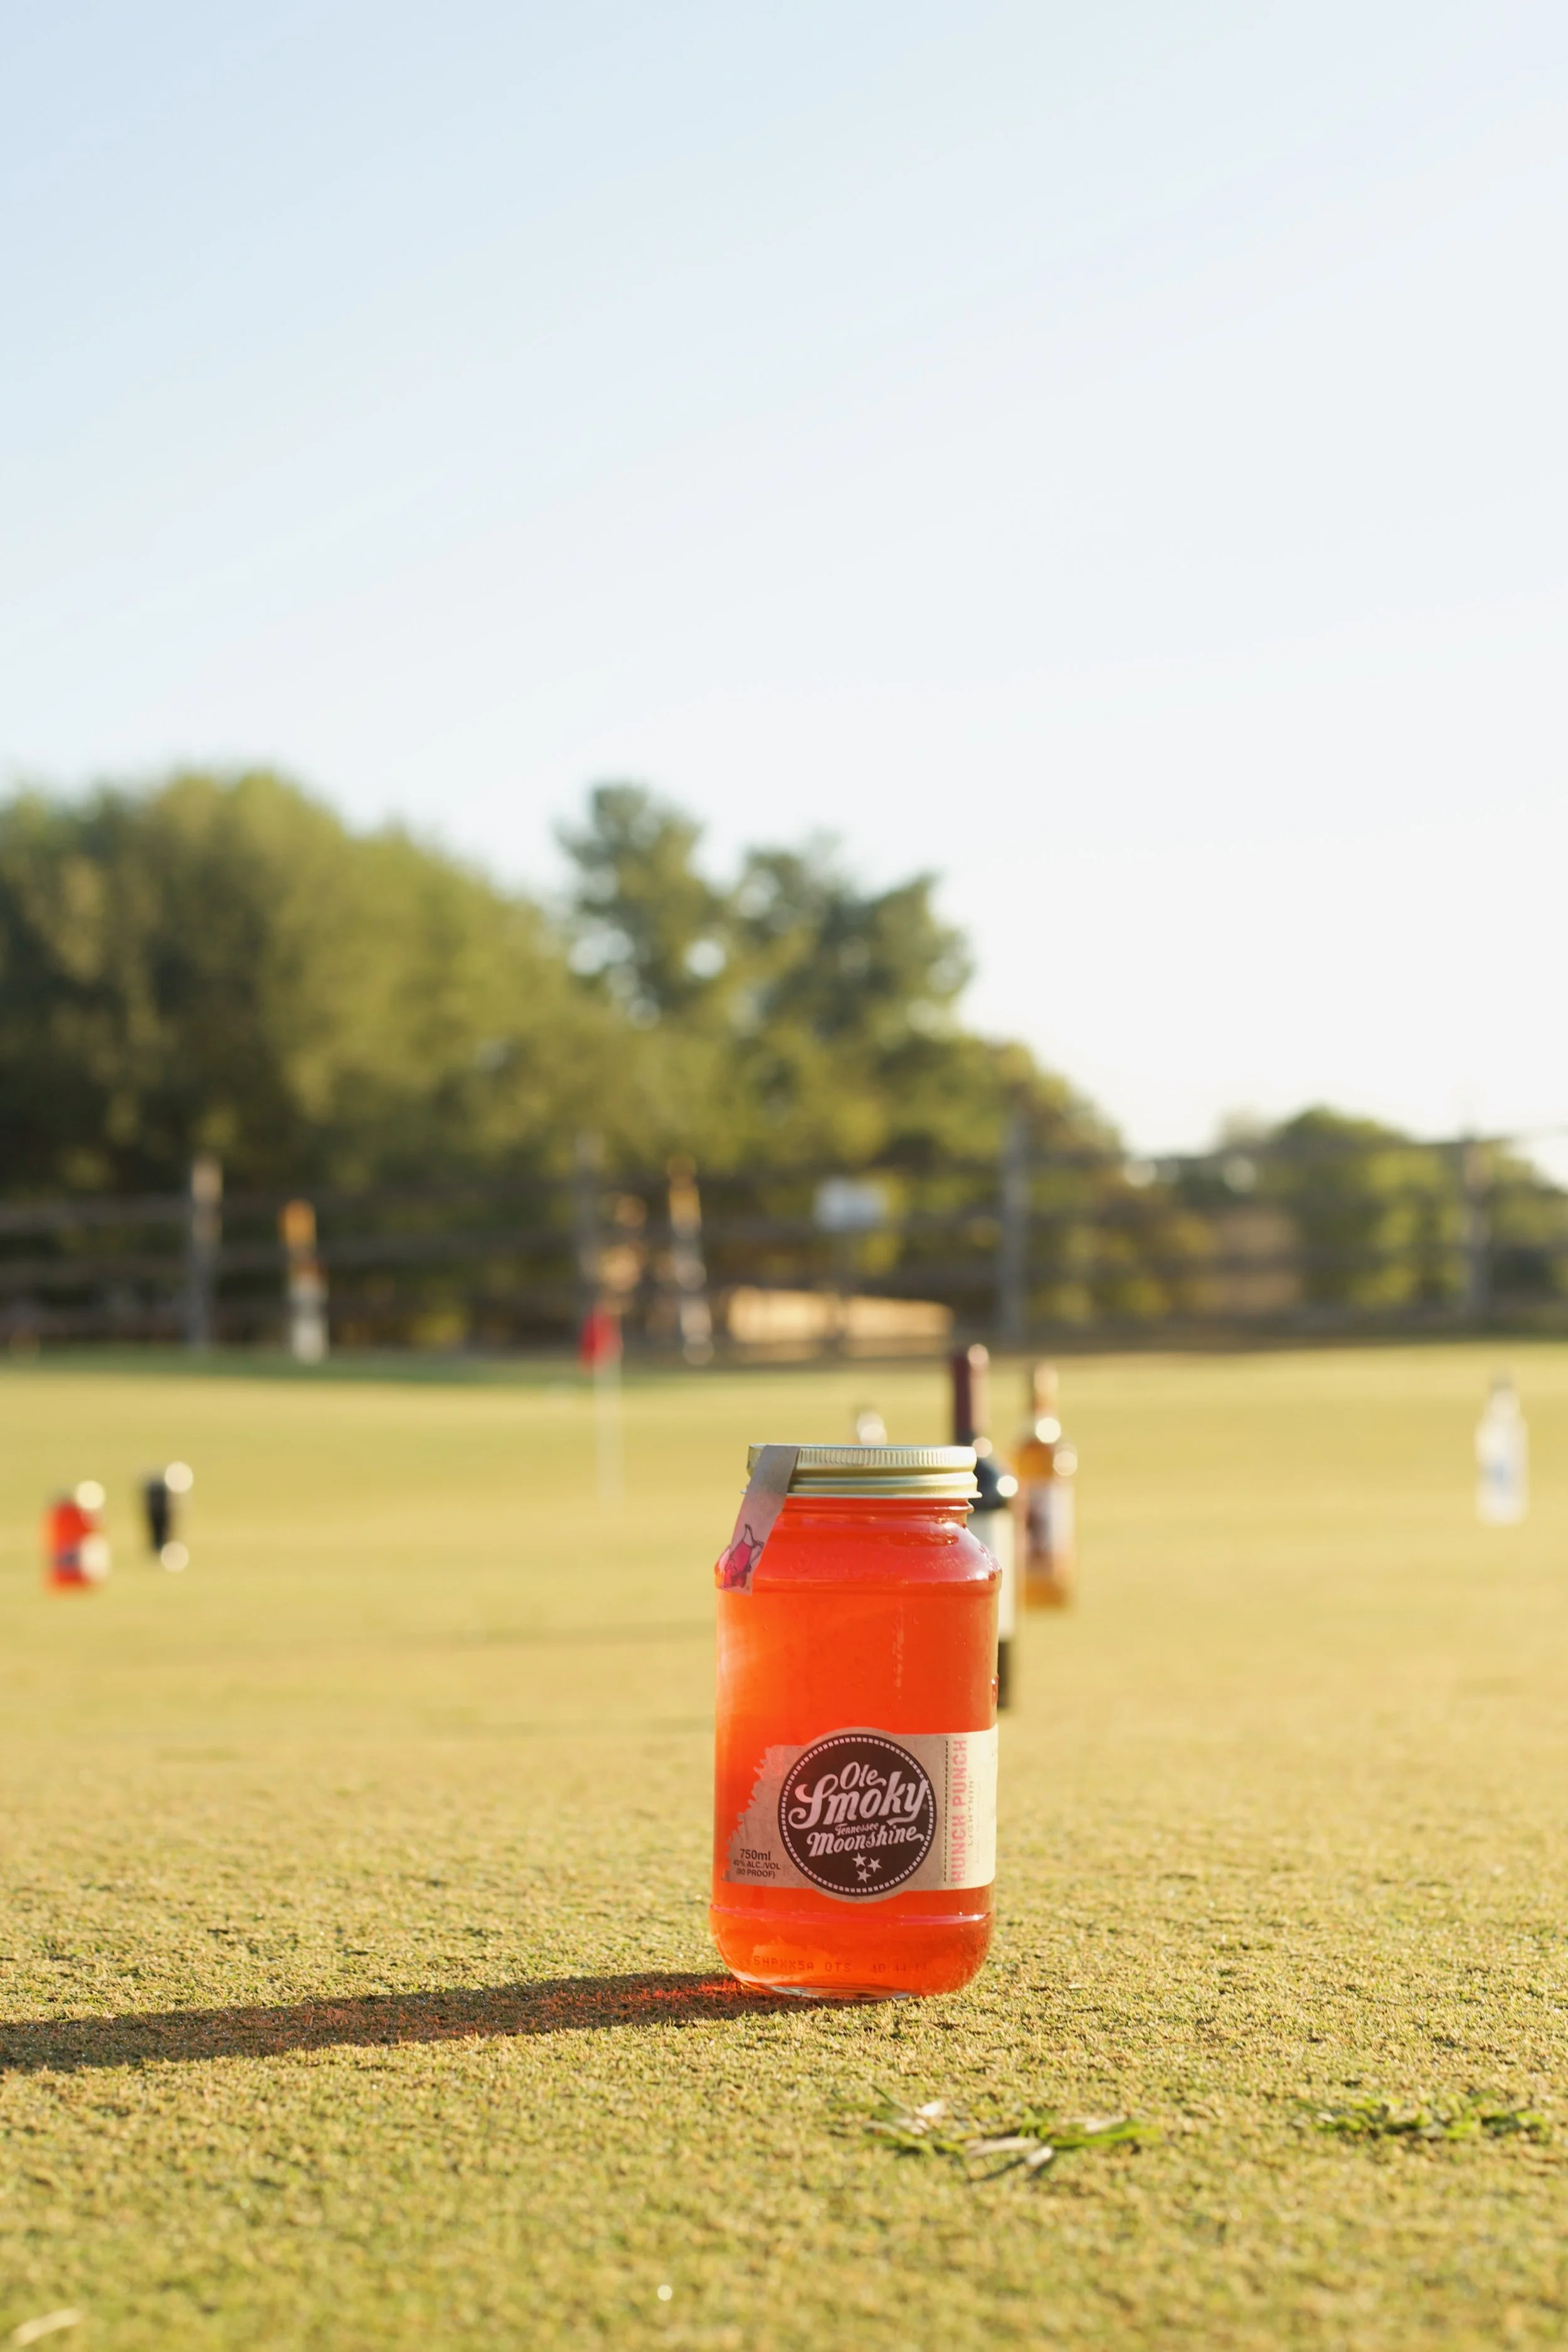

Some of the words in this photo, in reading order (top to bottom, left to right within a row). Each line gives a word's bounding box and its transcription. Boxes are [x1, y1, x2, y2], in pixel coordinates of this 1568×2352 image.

[840, 1761, 887, 1790] Ole
[952, 1740, 967, 1807] PUNCH
[788, 1771, 929, 1830] Smoky
[807, 1825, 925, 1857] Moonshine
[835, 1822, 879, 1836] Tennessee
[740, 1848, 771, 1861] 750ml
[951, 1815, 967, 1882] HUNCH
[747, 1868, 775, 1880] PROOF)
